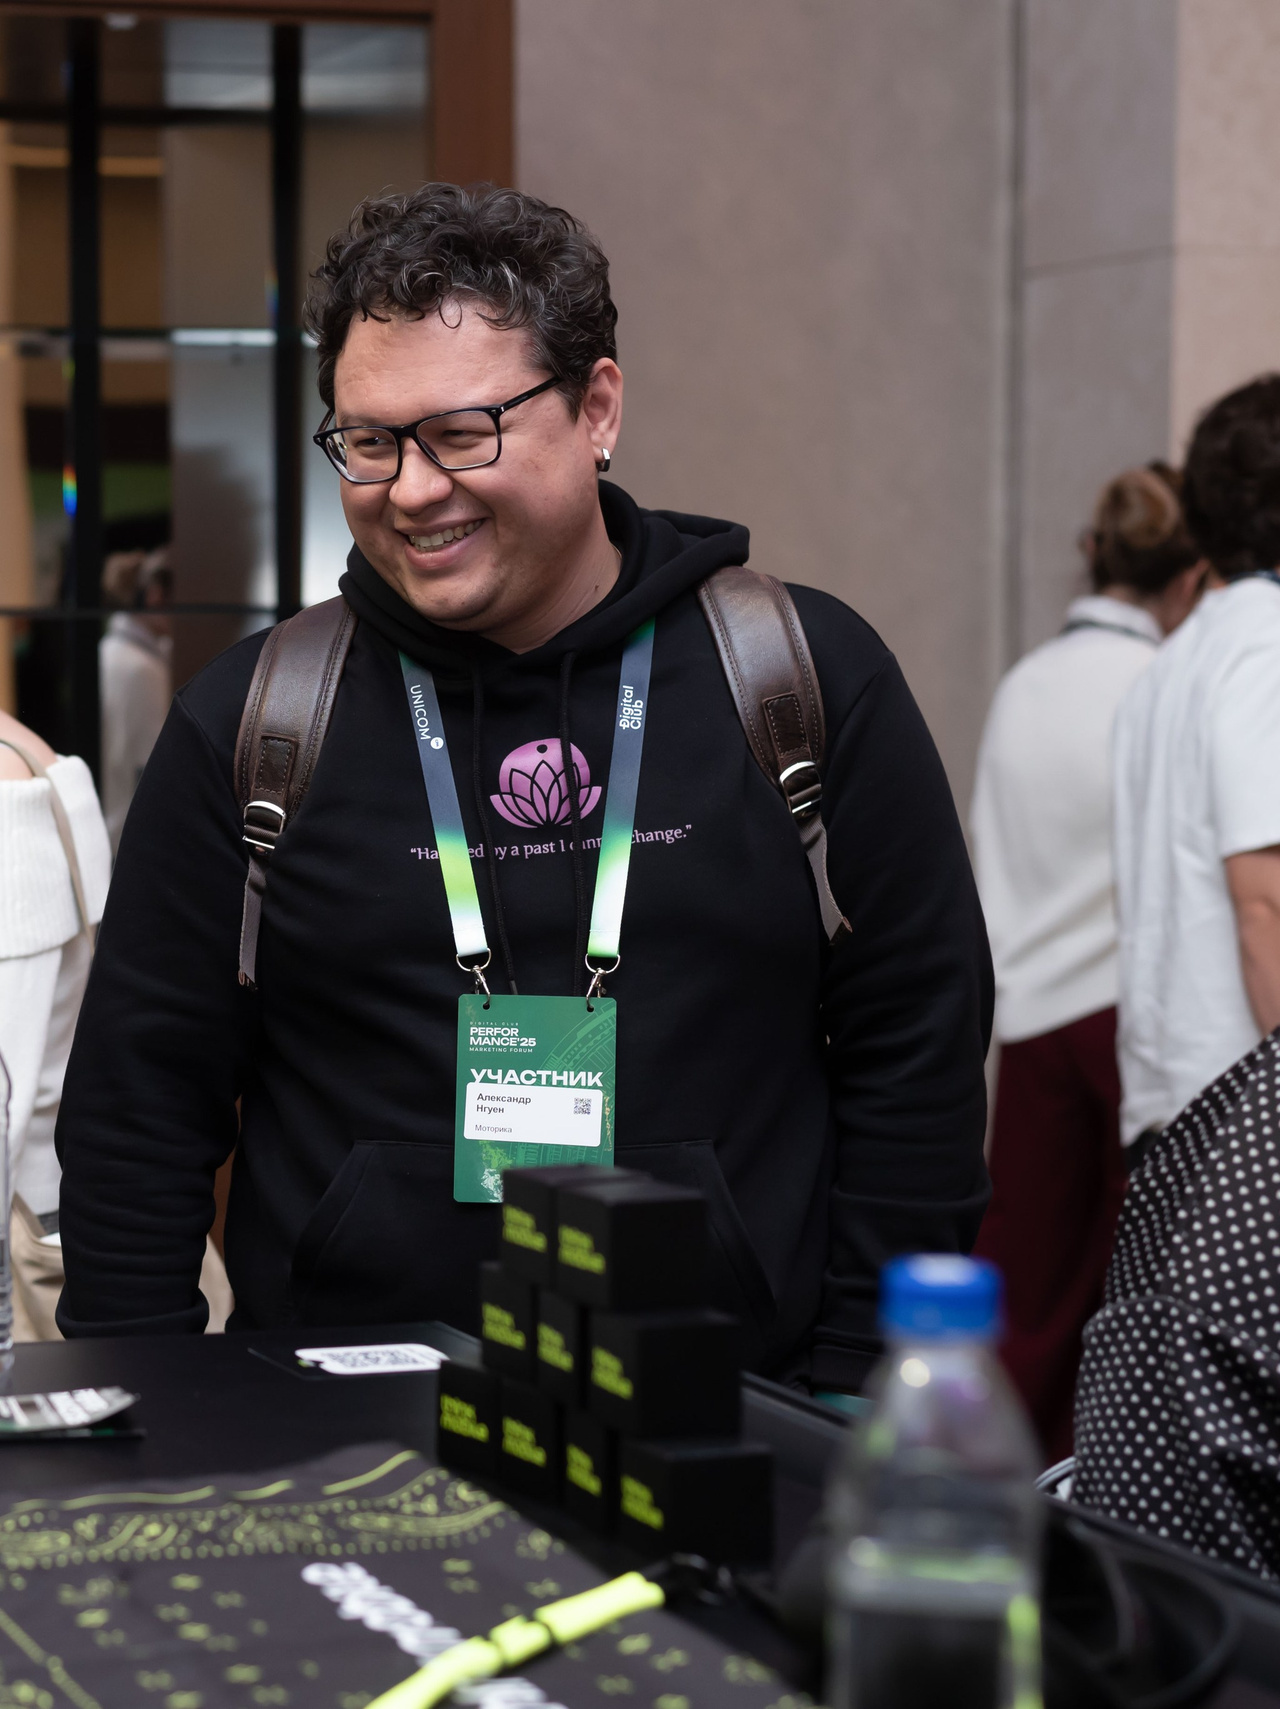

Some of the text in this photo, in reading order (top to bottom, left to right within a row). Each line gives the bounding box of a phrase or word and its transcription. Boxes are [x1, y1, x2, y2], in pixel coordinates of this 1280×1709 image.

[410, 684, 431, 740] UNICOM
[630, 699, 644, 730] Club
[410, 843, 485, 860] “Haed
[511, 845, 520, 856] a
[523, 842, 556, 859] past
[470, 1026, 519, 1037] PERFOR
[469, 1036, 537, 1047] MANCE'25
[470, 1068, 603, 1087] УЧАСТНИК
[477, 1092, 532, 1106] Александр
[476, 1104, 505, 1115] Нгуен
[474, 1124, 513, 1134] Моторика
